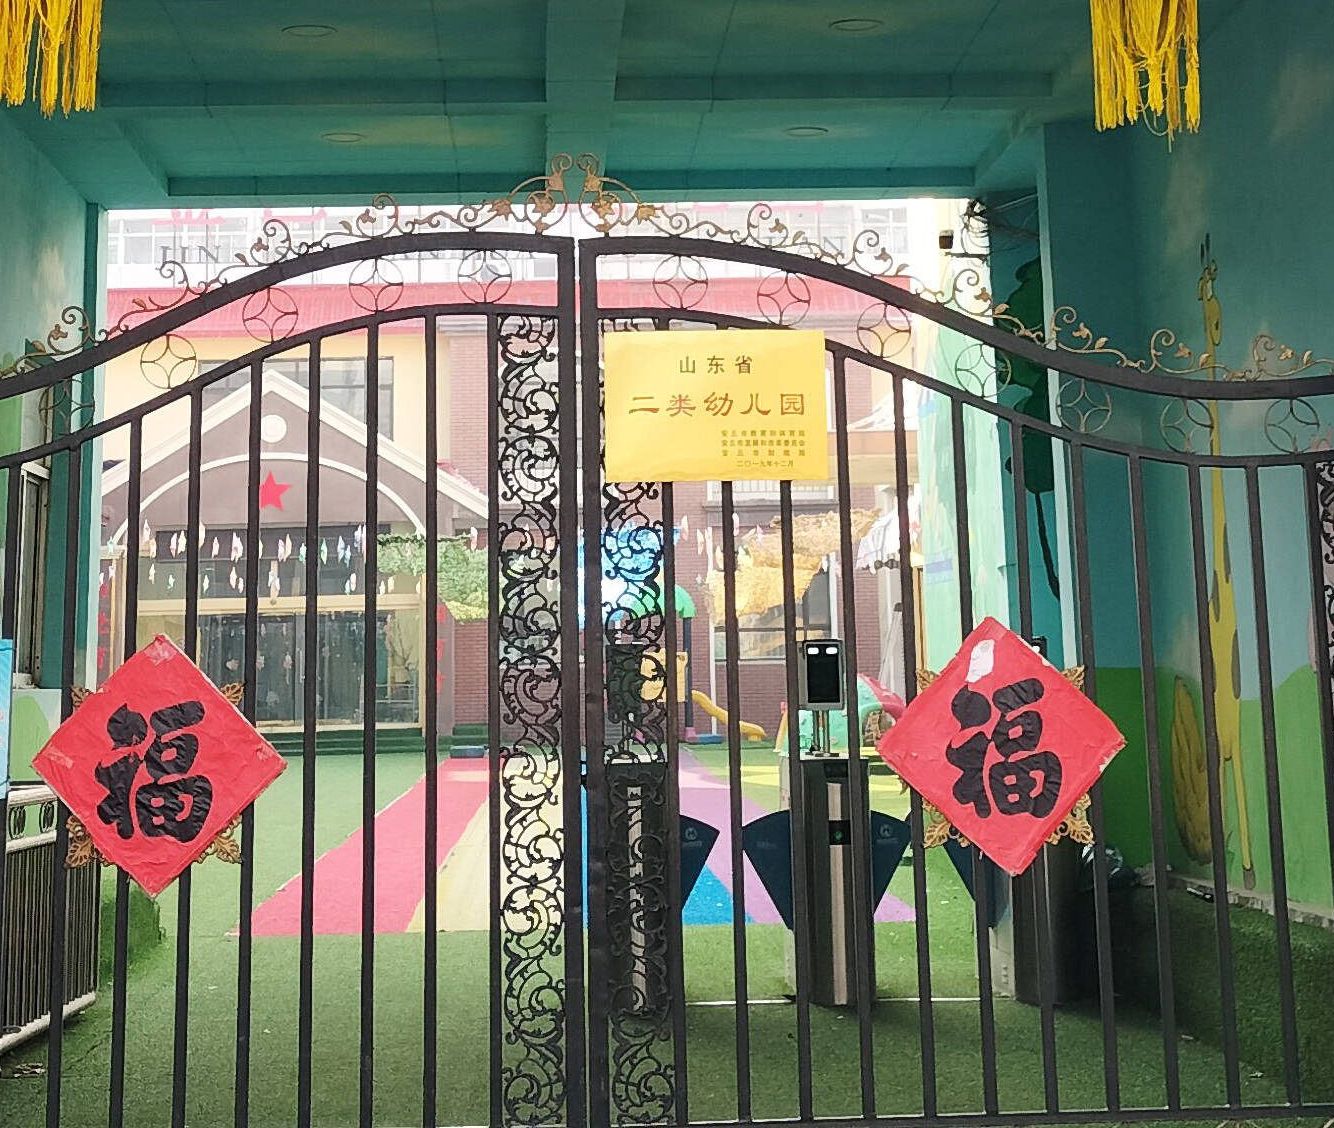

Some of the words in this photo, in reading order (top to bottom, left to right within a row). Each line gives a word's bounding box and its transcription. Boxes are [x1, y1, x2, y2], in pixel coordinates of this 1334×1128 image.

[628, 391, 806, 417] 二类幼儿园
[679, 355, 754, 374] 山东省
[95, 701, 213, 843] 福
[945, 678, 1062, 818] 福
